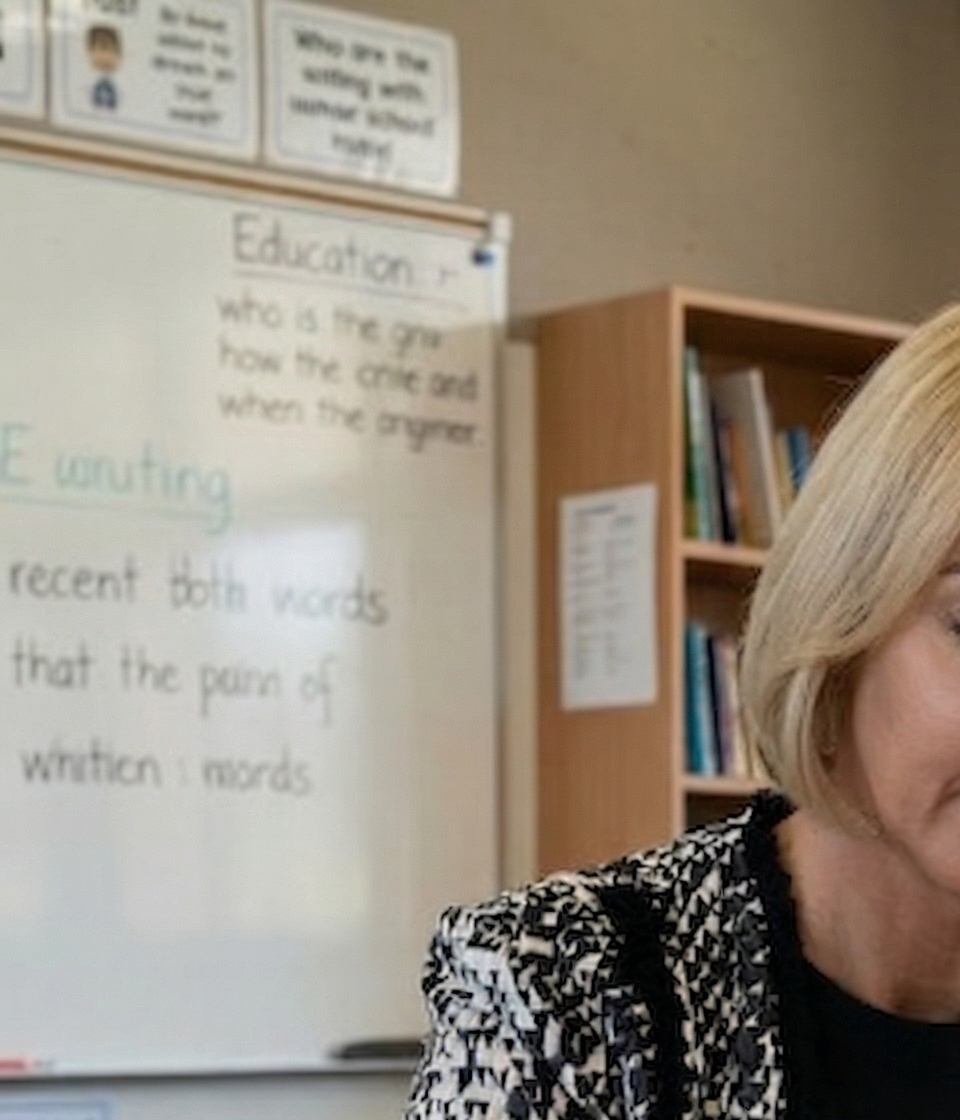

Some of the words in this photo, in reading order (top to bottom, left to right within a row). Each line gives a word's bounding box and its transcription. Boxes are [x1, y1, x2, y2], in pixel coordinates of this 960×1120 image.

[233, 212, 413, 287] Education
[216, 288, 282, 329] who
[333, 305, 380, 344] the
[217, 335, 281, 375] how
[295, 347, 342, 384] the
[217, 389, 305, 424] when
[317, 398, 365, 433] the
[9, 553, 138, 604] recent
[12, 635, 92, 689] that
[120, 643, 181, 694] the
[300, 653, 337, 728] of
